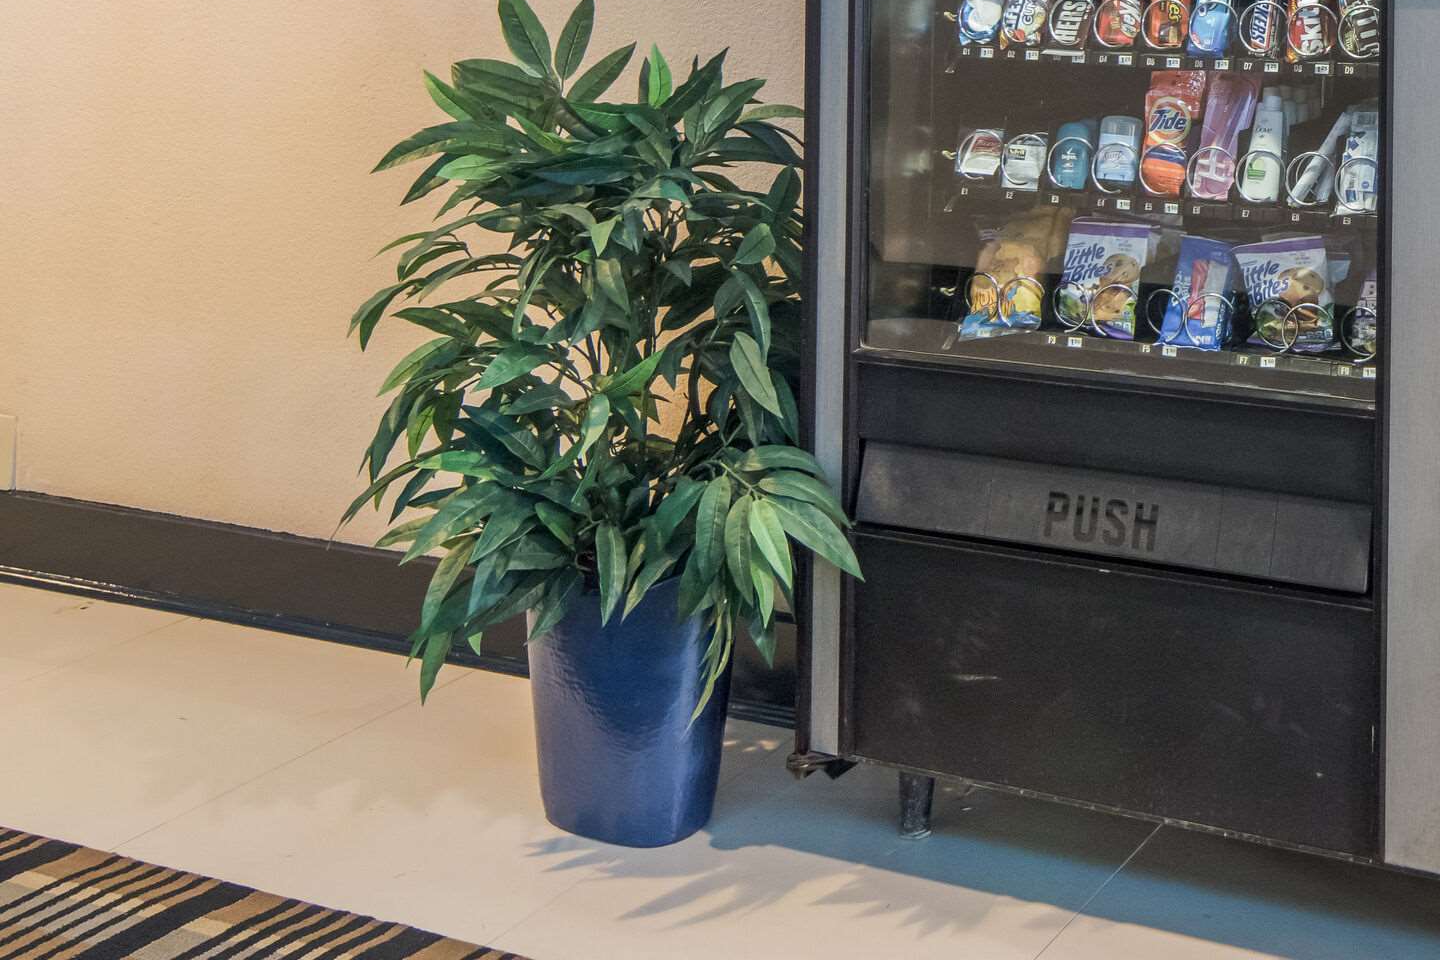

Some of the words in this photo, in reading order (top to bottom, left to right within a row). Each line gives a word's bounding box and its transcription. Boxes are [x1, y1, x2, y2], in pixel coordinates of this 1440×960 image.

[1244, 63, 1253, 71] D7
[1345, 66, 1354, 75] D9
[1150, 109, 1187, 132] Tide
[1239, 357, 1248, 365] F7
[1044, 492, 1159, 551] PUSH
